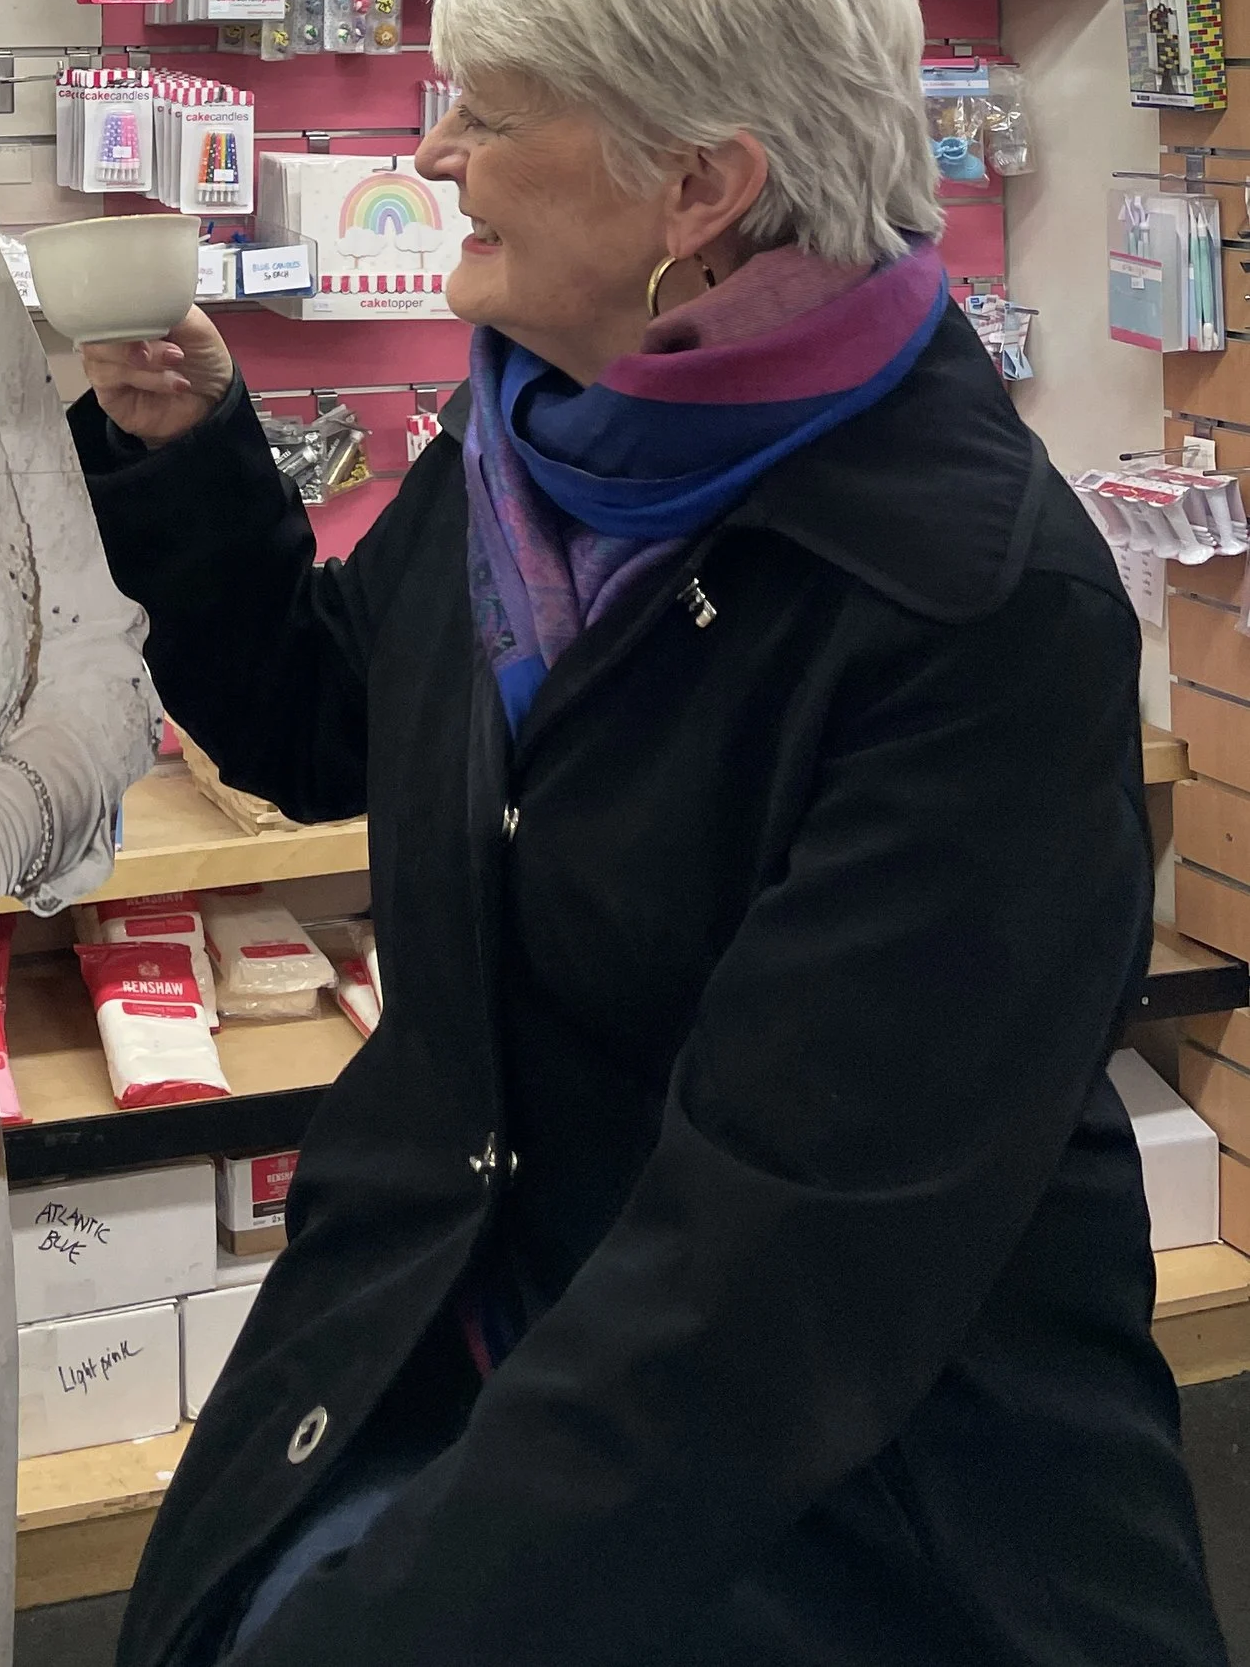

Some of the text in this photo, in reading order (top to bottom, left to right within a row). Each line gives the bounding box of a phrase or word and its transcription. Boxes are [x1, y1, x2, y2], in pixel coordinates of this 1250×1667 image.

[85, 90, 150, 101] cakecandles
[185, 112, 249, 122] cakecandles
[360, 297, 424, 308] caketopper
[122, 980, 183, 996] RENSHAW
[35, 1201, 111, 1245] ATLANTIC
[38, 1229, 87, 1265] BLUE
